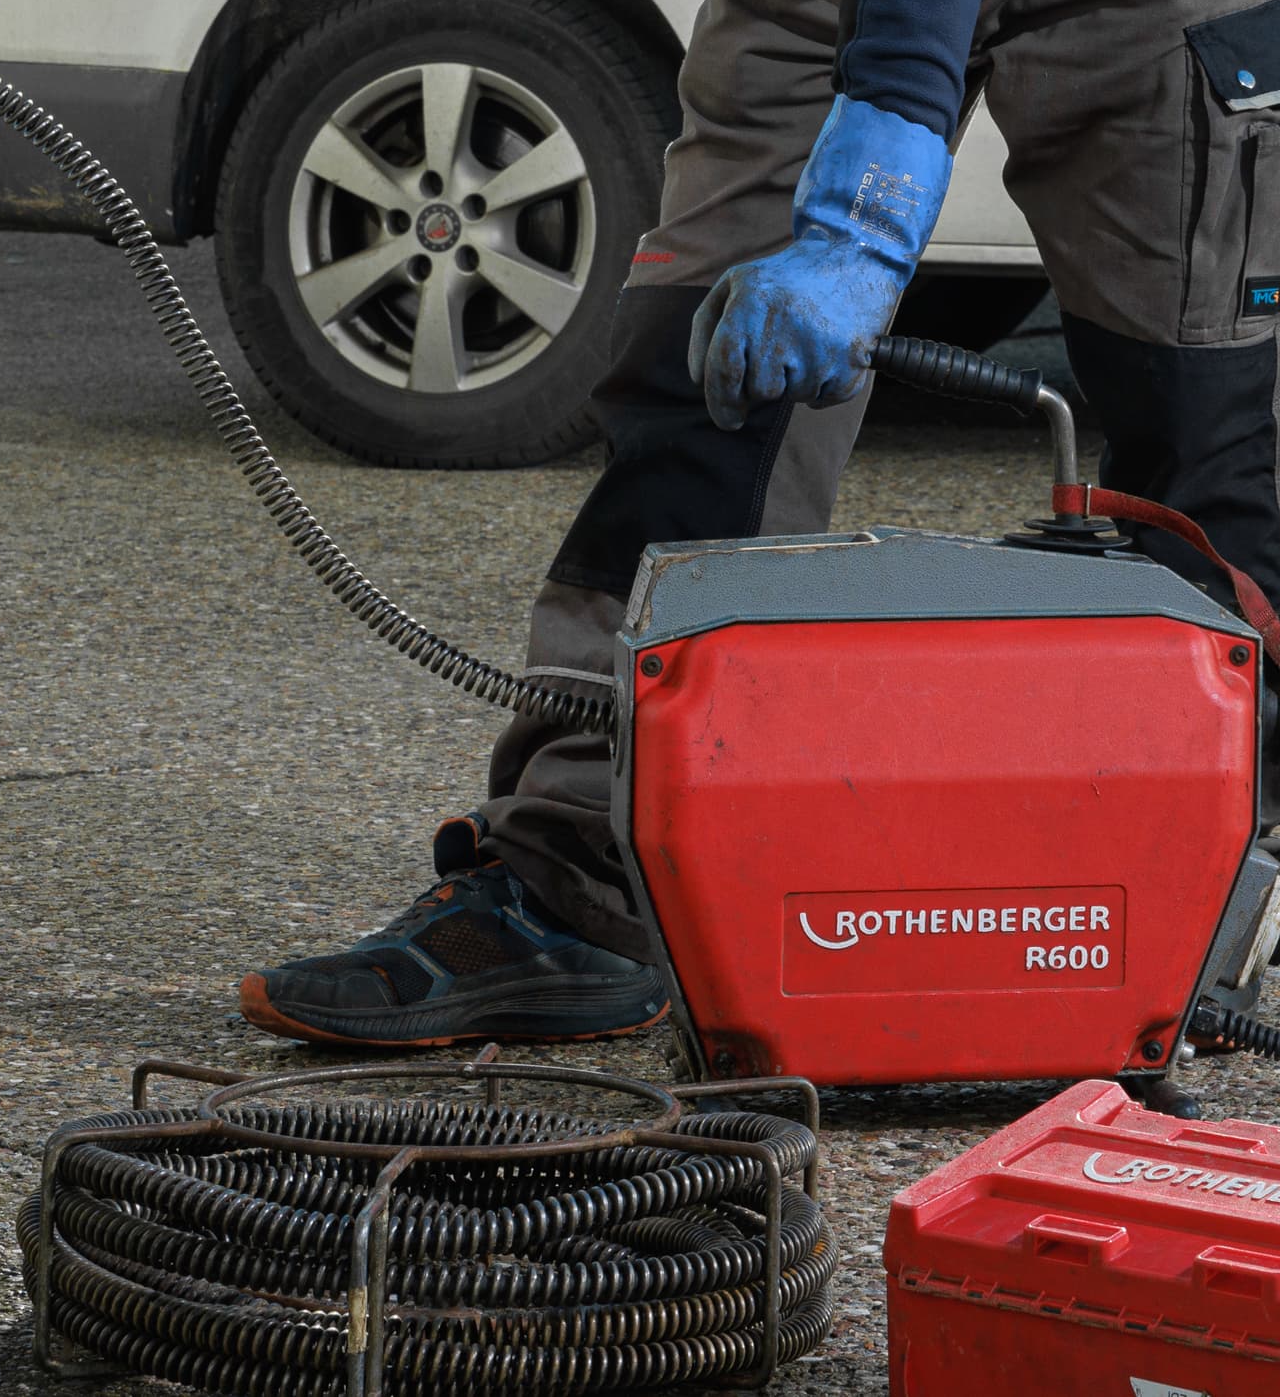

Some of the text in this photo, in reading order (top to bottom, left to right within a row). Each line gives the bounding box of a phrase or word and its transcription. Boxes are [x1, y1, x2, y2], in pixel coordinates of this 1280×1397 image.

[849, 172, 874, 222] GUIDE
[835, 905, 1111, 936] ROTHENBERGER
[1024, 945, 1110, 971] R600
